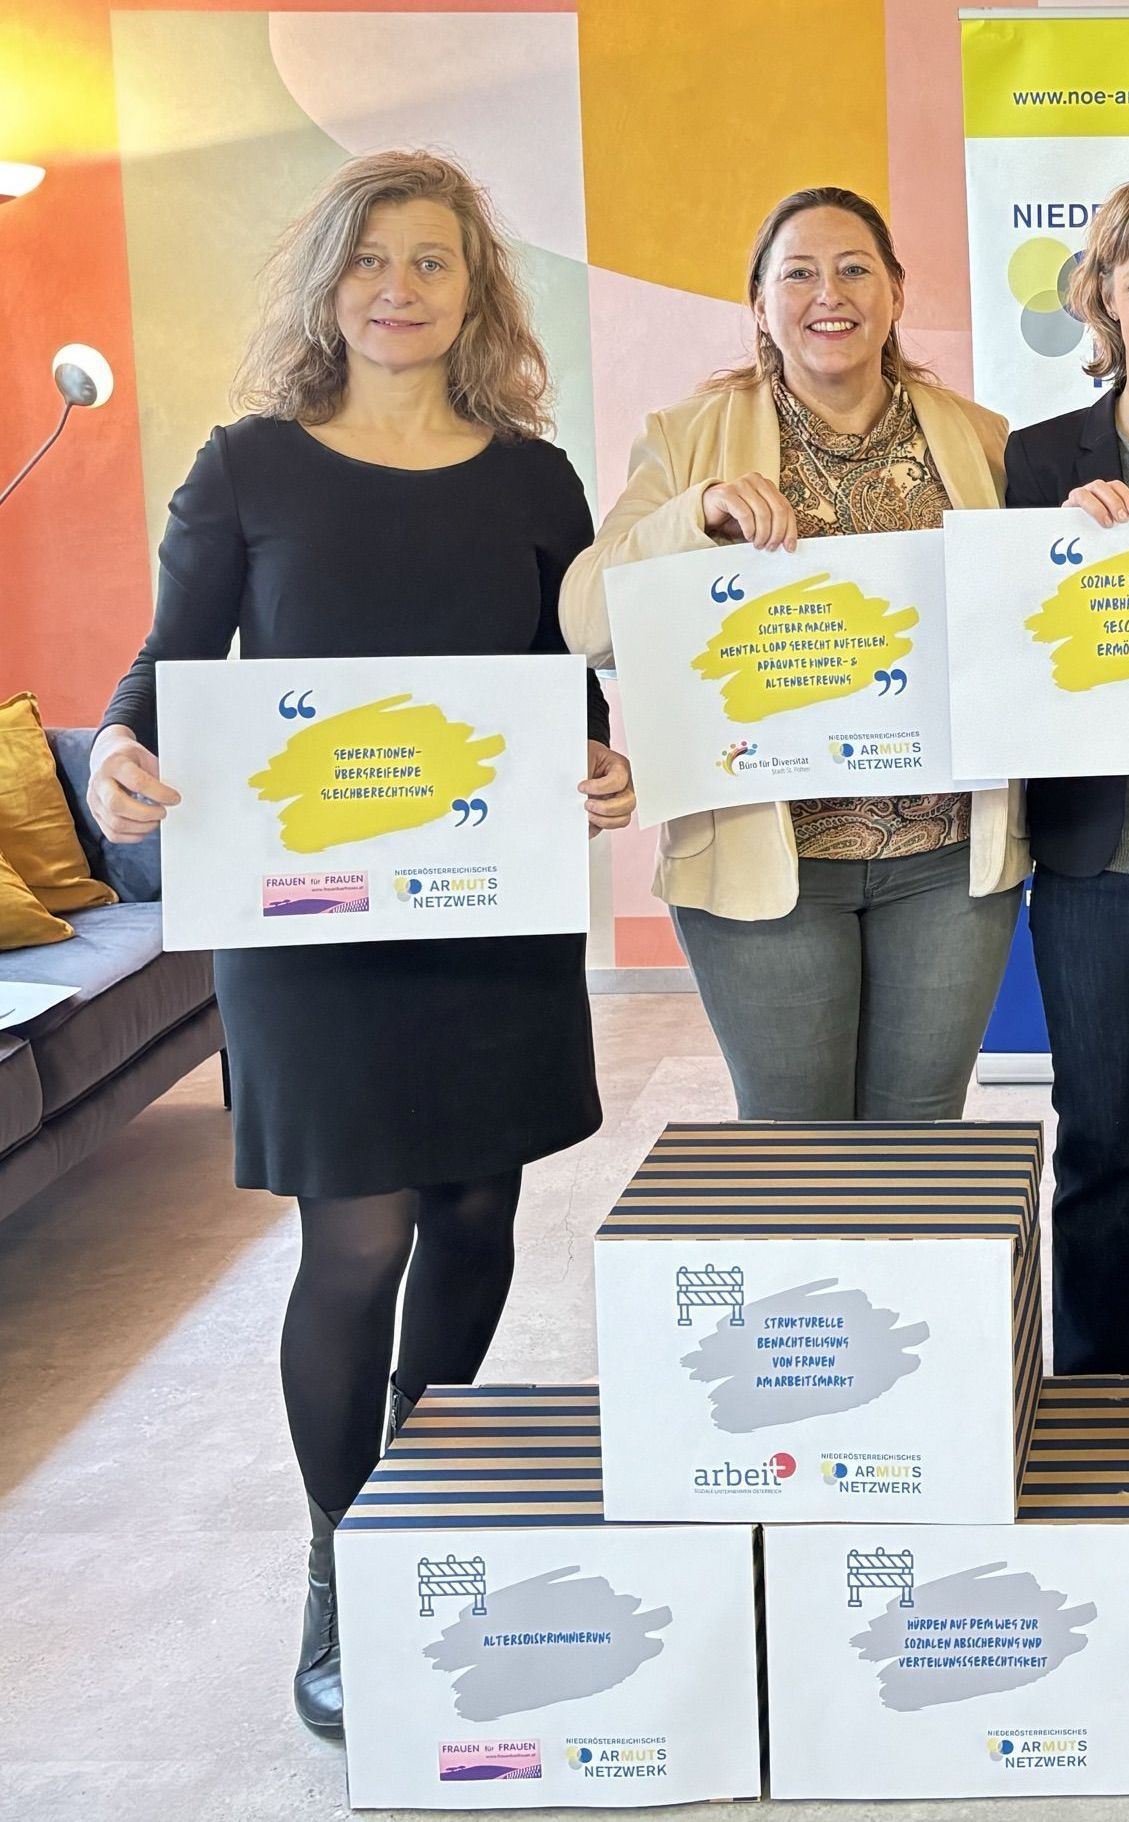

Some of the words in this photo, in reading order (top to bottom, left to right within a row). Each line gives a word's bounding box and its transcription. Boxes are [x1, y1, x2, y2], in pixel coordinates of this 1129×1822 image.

[1080, 575, 1125, 588] SOZIALE
[768, 603, 832, 616] CARE-ARBEIT
[759, 621, 803, 635] SICHTBAR
[805, 620, 847, 632] MACHEN.
[720, 645, 761, 658] MENTAL
[763, 641, 787, 653] LOAD
[788, 639, 830, 651] GERECHT
[834, 635, 889, 649] AUFTEILEN.
[757, 657, 807, 671] ADÄQUATE
[809, 657, 848, 668] KINDER-
[765, 673, 851, 689] ALTENBETREUUNG
[828, 731, 920, 741] NIEDERÖSTERREICHISCHES
[334, 747, 422, 761] GENERATIONEN-
[860, 742, 921, 756] ARMUTS
[739, 761, 757, 770] Büro
[847, 757, 923, 770] NETZWERK
[335, 765, 422, 780] ÜBERGREIFENDE
[320, 785, 434, 800] GLEICHBERECHTIGUNG
[394, 866, 498, 876] NIEDERÖSTERREICHISCHES
[267, 878, 305, 887] FRAUEN
[325, 875, 363, 884] FRAUEN
[429, 877, 498, 892] ARMUTS
[413, 894, 498, 908] NETZWERK
[764, 1317, 844, 1330] STRUKTURELLE
[757, 1336, 849, 1349] BENACHTEILIGUNG
[772, 1356, 793, 1368] VON
[795, 1355, 836, 1367] FRAUEN
[756, 1376, 772, 1388] AM
[774, 1375, 855, 1388] ARBEITSMARKT
[821, 1453, 922, 1461] NIEDERÖSTERREICHISCHES
[855, 1465, 922, 1478] ARMUTS
[839, 1481, 922, 1494] NETZWERK
[907, 1617, 948, 1631] HÜRDEN
[949, 1618, 968, 1630] AUF
[970, 1618, 993, 1630] DEM
[995, 1618, 1018, 1632] WEG
[1020, 1618, 1039, 1630] ZUR
[483, 1632, 611, 1647] ALTERSDISKRIMINIERUNG
[905, 1637, 952, 1649] SOZIALEN
[954, 1637, 1021, 1650] ABSICHERUNG
[1022, 1637, 1042, 1649] UND
[899, 1655, 1048, 1669] VERTEILUNGSGERECHTIGKEIT
[498, 1743, 536, 1751] FRAUEN
[566, 1736, 666, 1745] NIEDERÖSTERREICHISCHES
[1021, 1739, 1088, 1752] ARMUTS
[600, 1748, 667, 1762] ARMUTS
[1005, 1755, 1088, 1768] NETZWERK
[584, 1764, 667, 1778] NETZWERK
